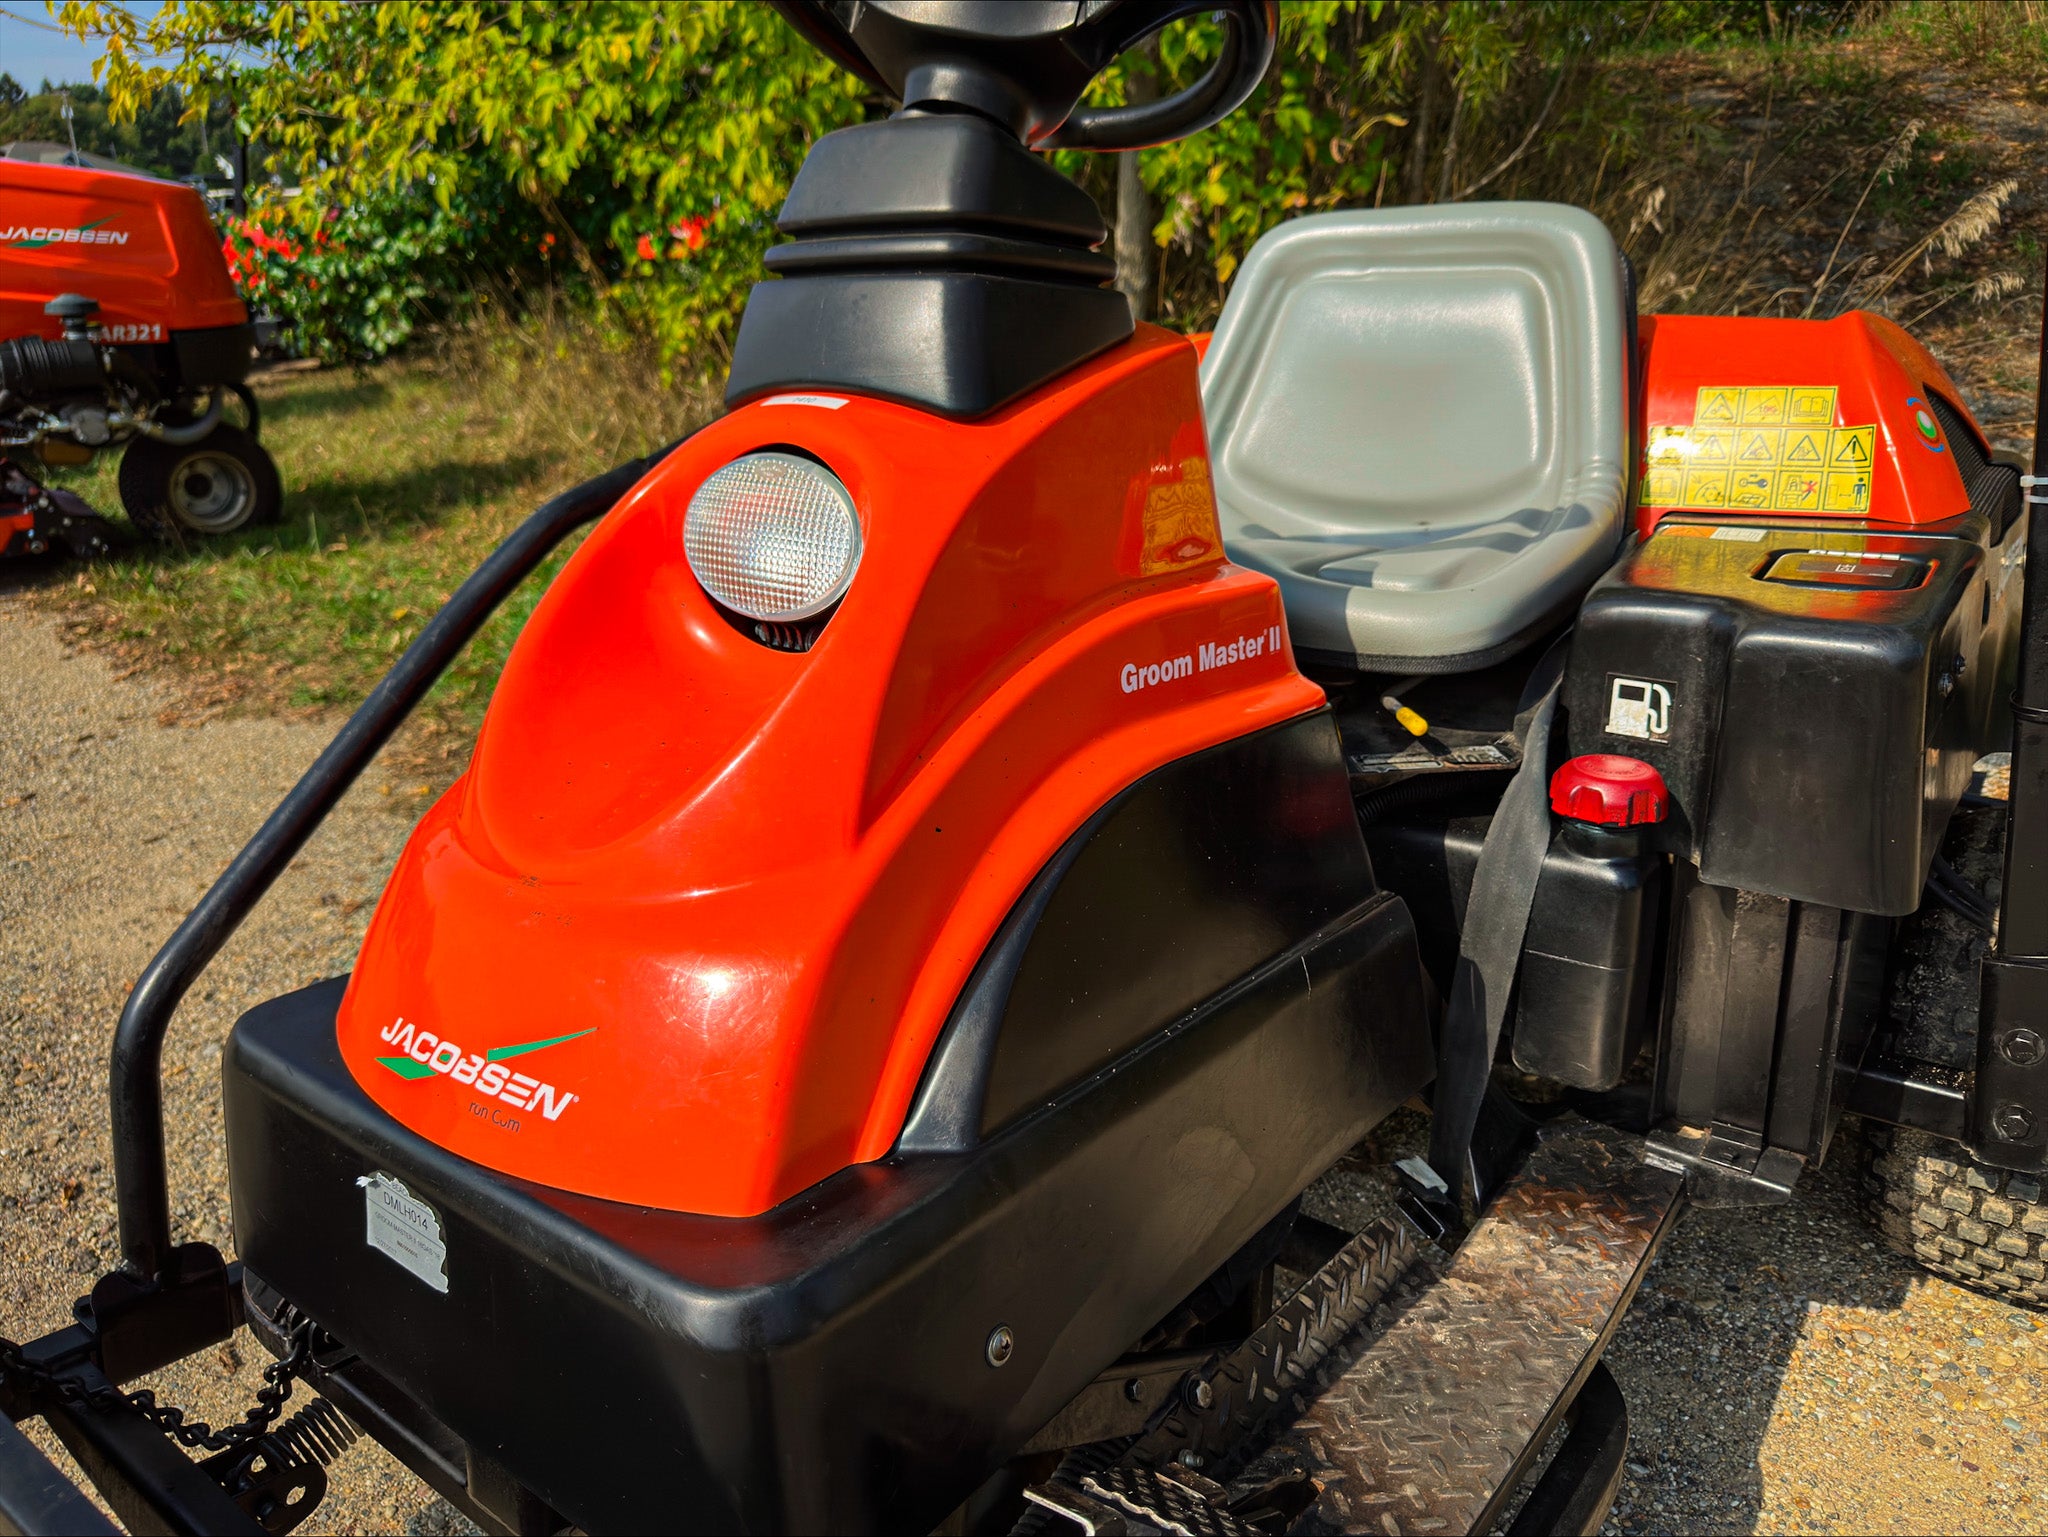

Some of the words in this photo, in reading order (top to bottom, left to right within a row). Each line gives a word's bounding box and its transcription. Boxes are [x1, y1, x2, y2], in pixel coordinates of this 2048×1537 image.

[0, 226, 129, 245] JACOBSEN
[1120, 653, 1193, 694] Groom
[1198, 635, 1265, 672] Master
[380, 1017, 575, 1121] JACOBSEN
[383, 1191, 429, 1231] DMLH014
